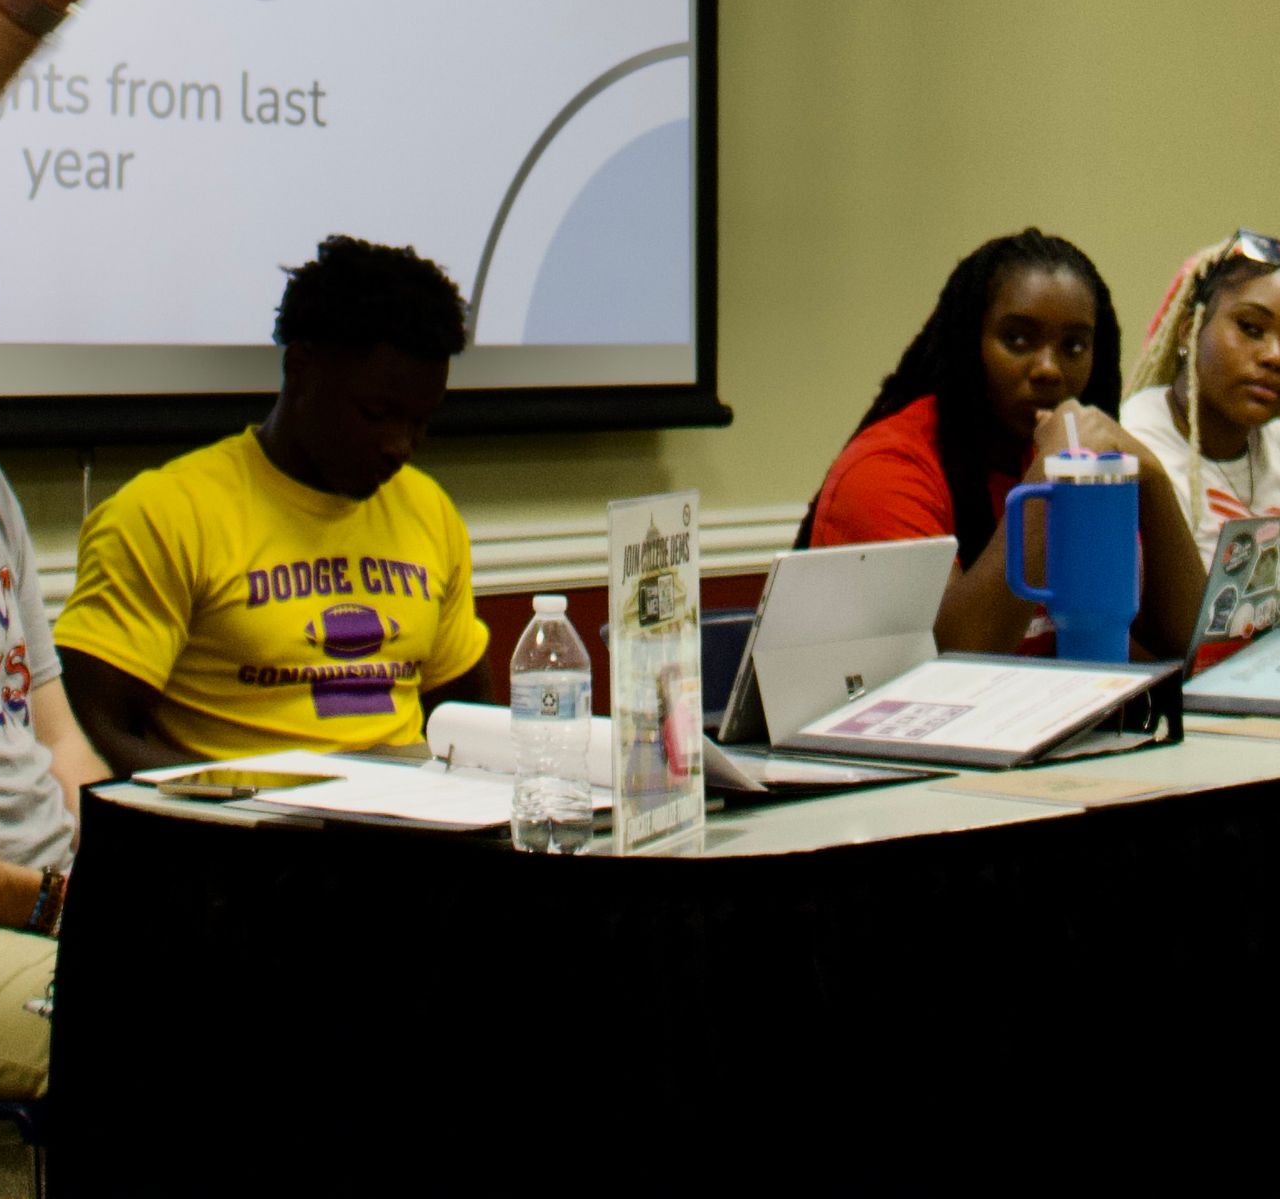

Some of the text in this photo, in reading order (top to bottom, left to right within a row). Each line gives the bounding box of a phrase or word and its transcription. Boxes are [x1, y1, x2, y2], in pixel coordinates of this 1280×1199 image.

[106, 61, 223, 123] from
[240, 69, 329, 129] last
[21, 146, 136, 201] year
[246, 556, 431, 610] DODGE CITY
[620, 542, 641, 587] JOIN
